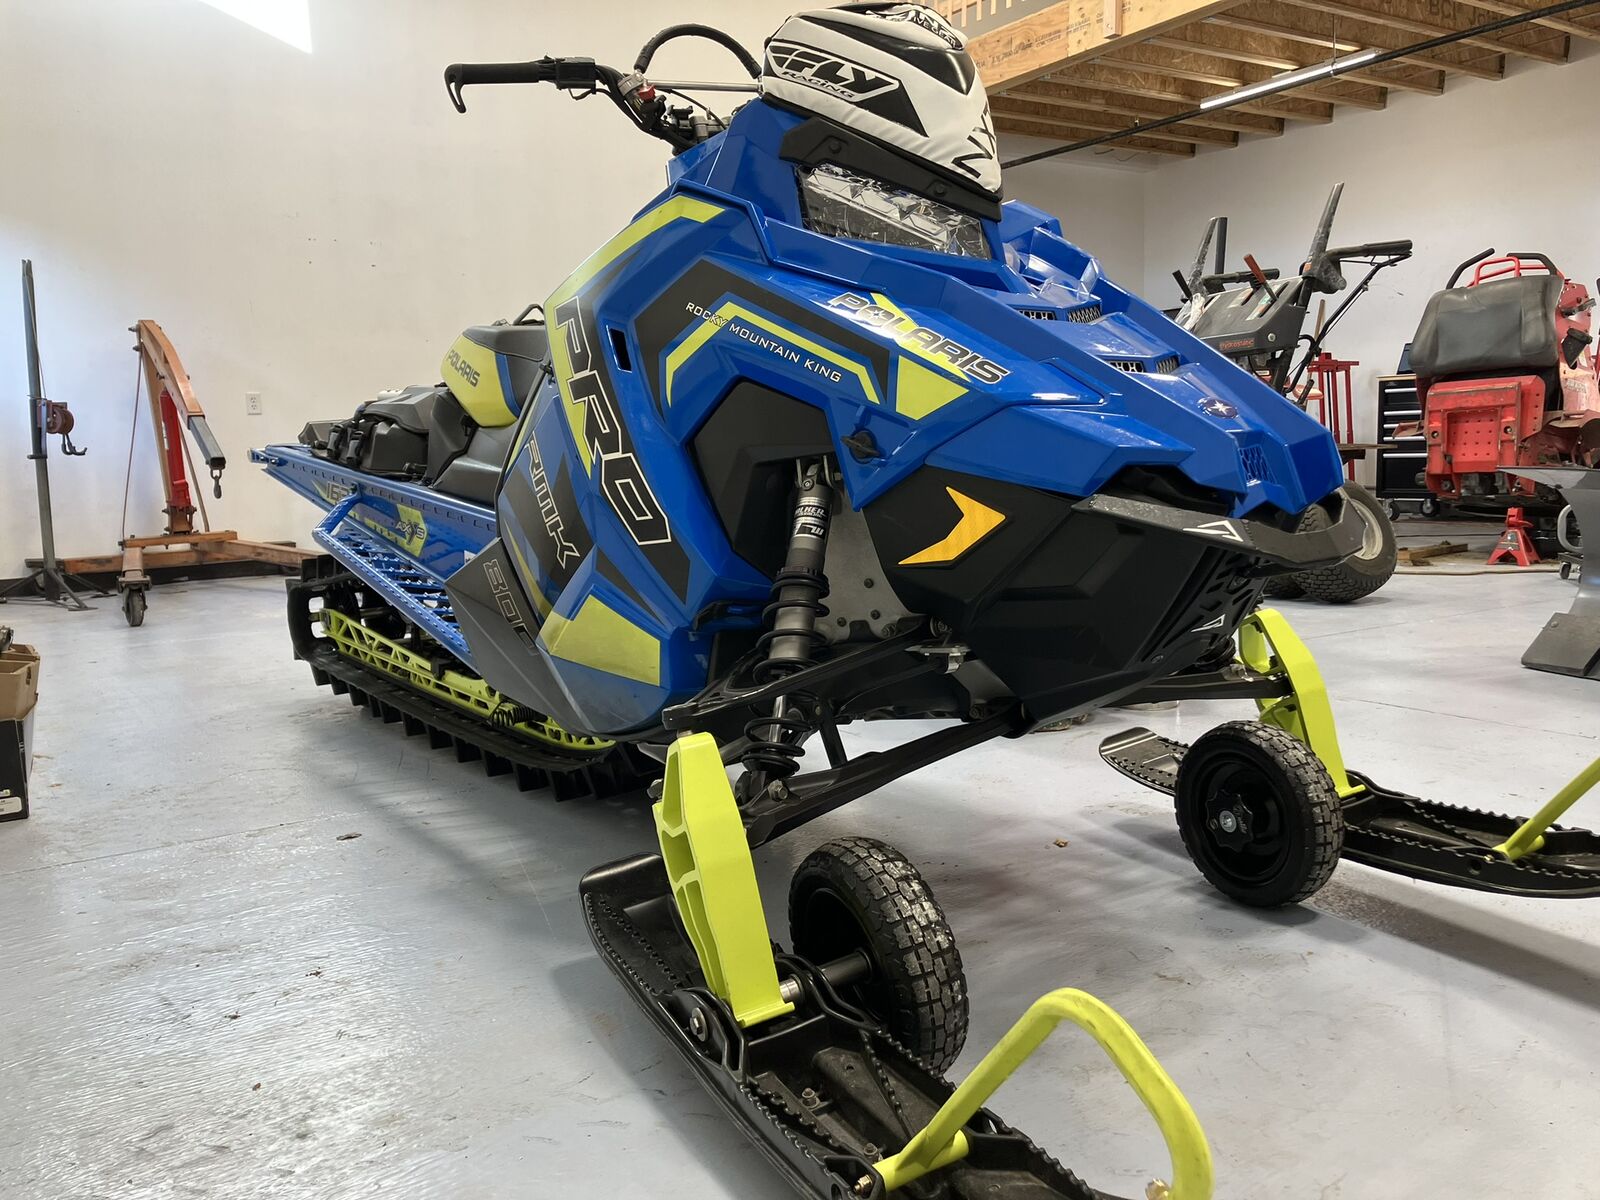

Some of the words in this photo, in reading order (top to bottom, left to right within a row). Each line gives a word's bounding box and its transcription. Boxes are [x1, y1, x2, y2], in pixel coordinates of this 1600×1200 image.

[769, 45, 895, 94] FLY
[446, 349, 481, 388] POLARIS
[685, 301, 729, 329] ROCKY
[729, 323, 801, 364] MOUNTAIN
[803, 358, 842, 384] KING
[828, 291, 1013, 385] POLARIS
[554, 295, 672, 546] PRO
[525, 431, 580, 569] RMK
